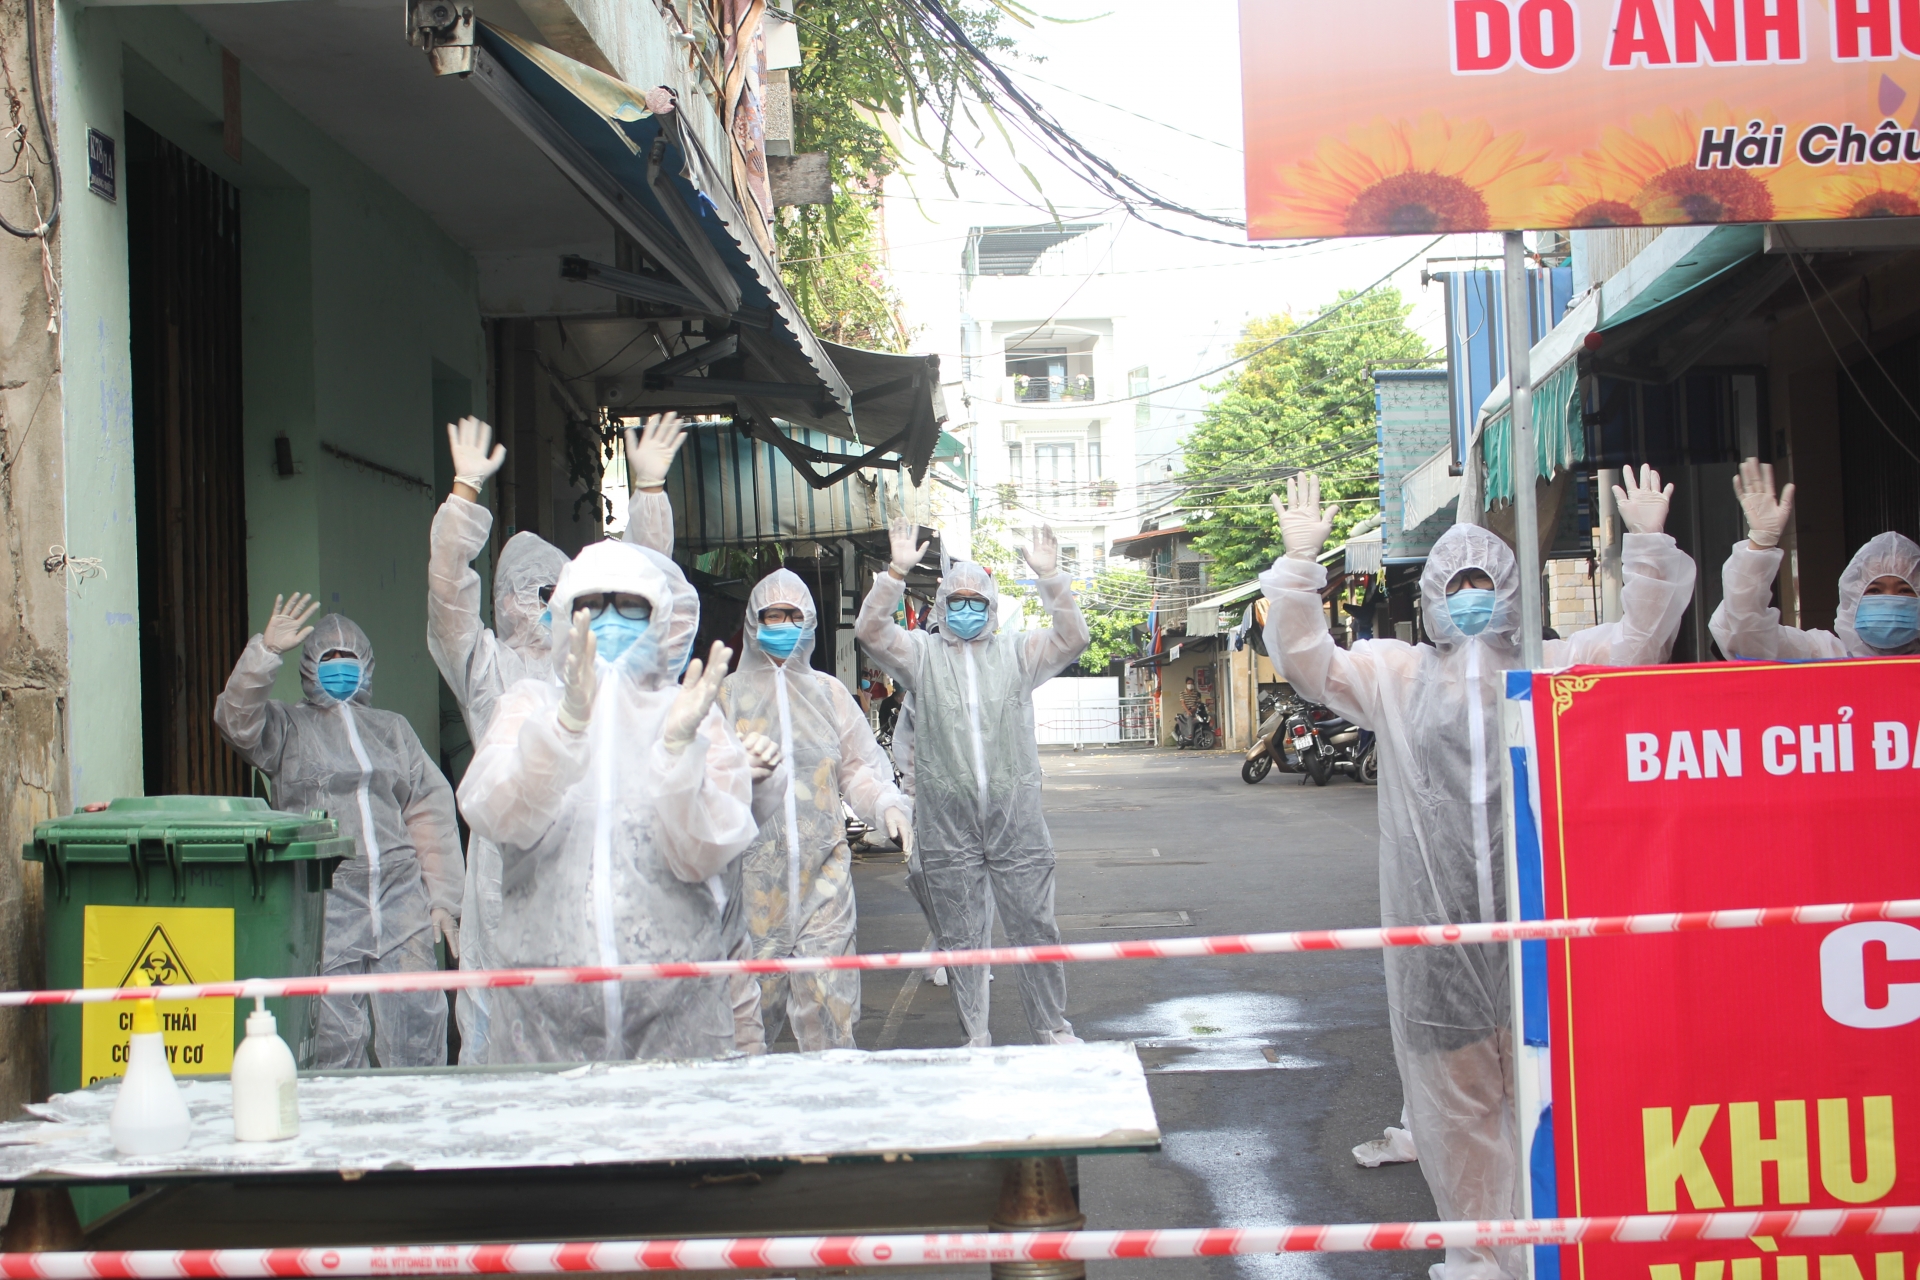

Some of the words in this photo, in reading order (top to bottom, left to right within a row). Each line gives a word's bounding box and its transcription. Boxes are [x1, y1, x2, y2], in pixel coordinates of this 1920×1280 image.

[1699, 121, 1784, 167] Hải
[1625, 728, 1743, 782] BAN
[1761, 706, 1855, 776] CHỈ
[1871, 720, 1920, 771] Đ
[163, 1006, 197, 1031] THẢI
[183, 1044, 204, 1064] CƠ
[1641, 1095, 1896, 1212] KHU
